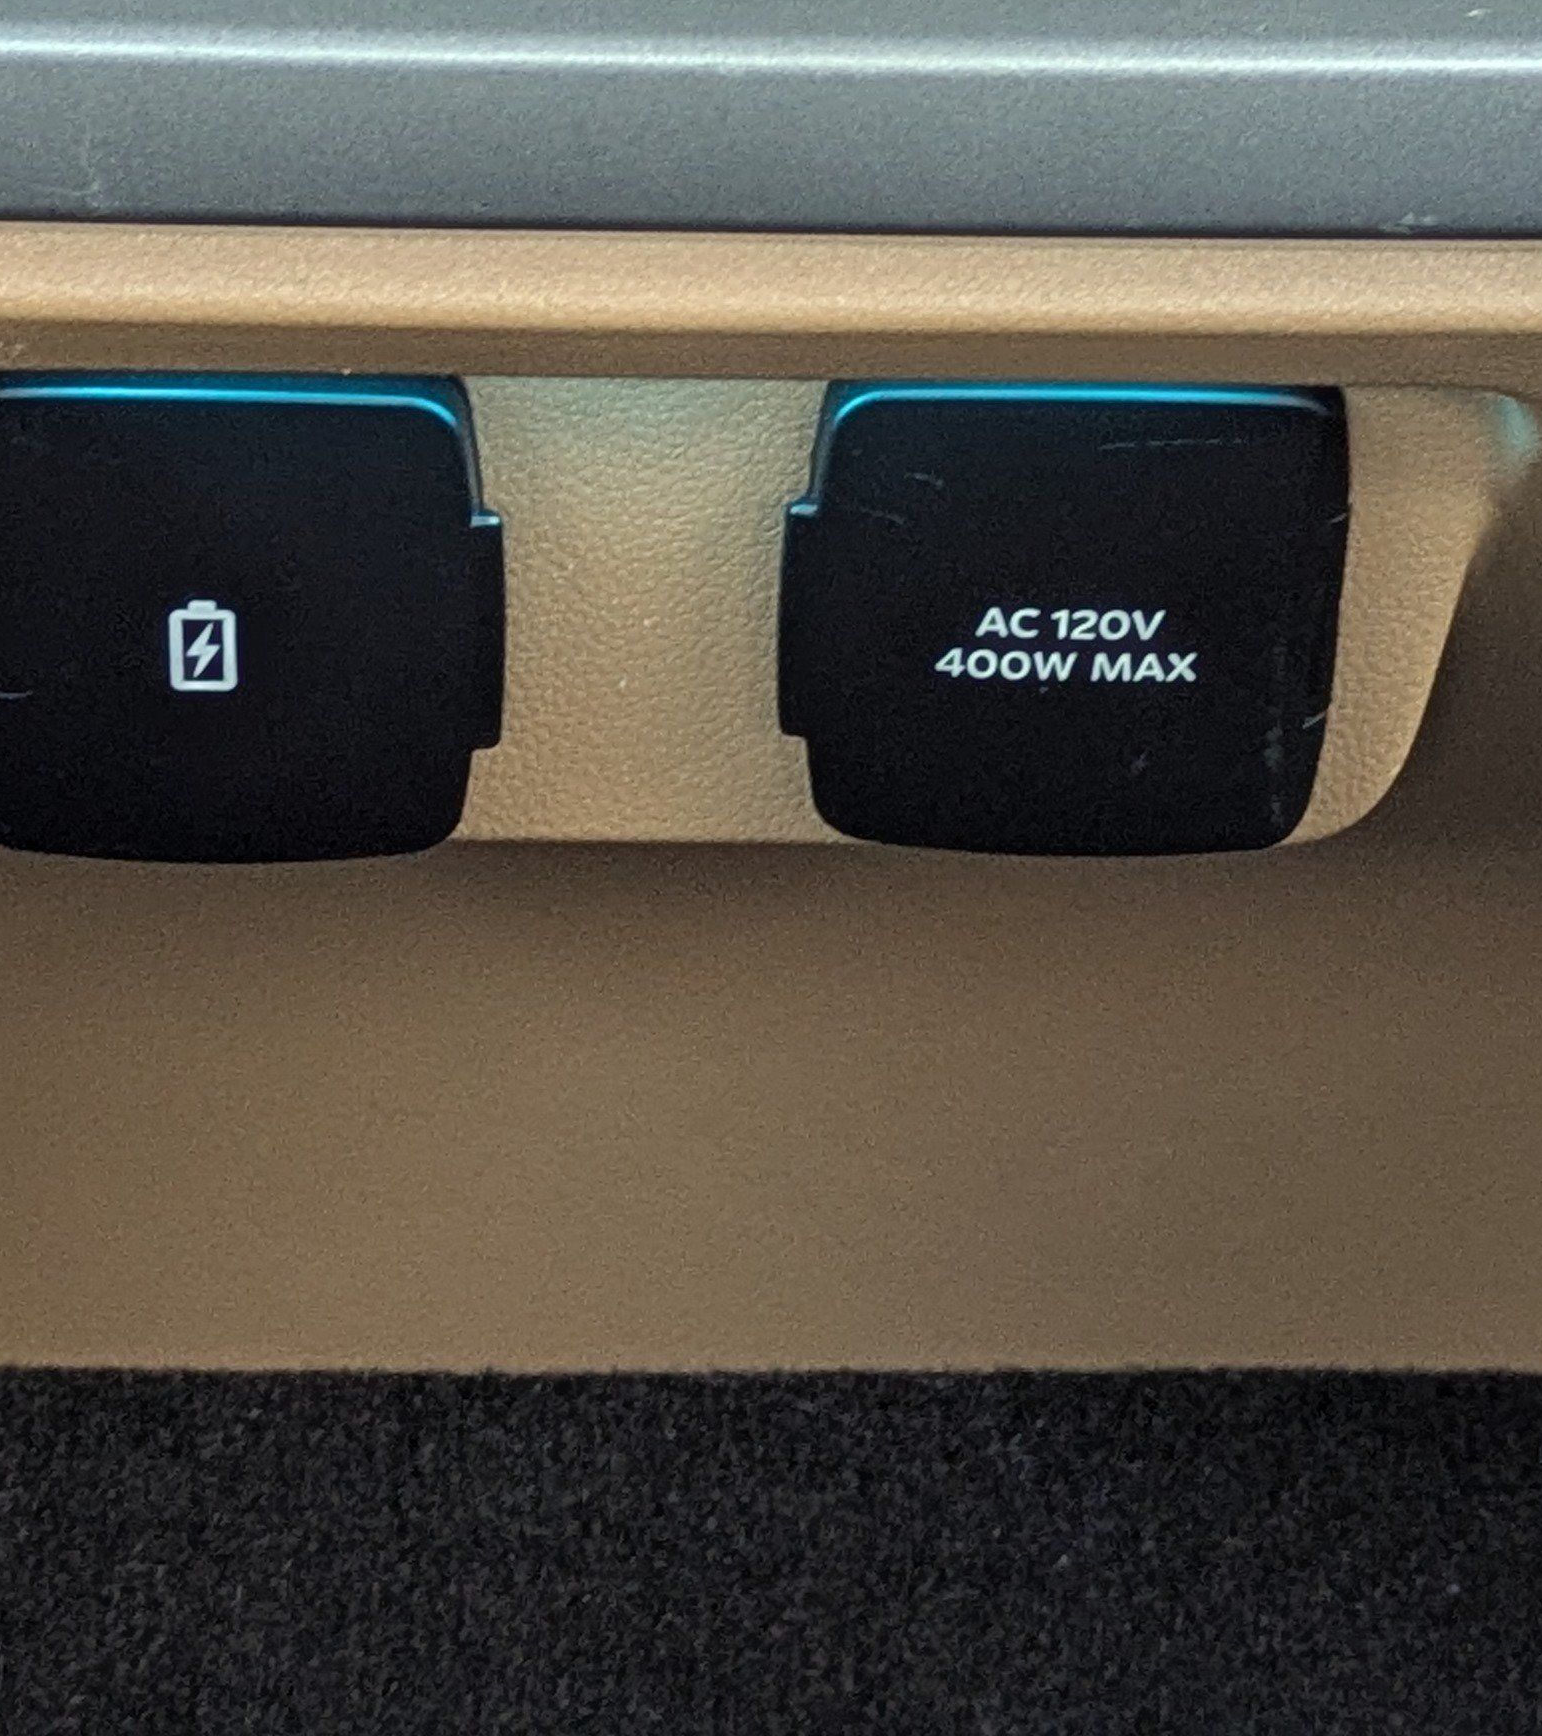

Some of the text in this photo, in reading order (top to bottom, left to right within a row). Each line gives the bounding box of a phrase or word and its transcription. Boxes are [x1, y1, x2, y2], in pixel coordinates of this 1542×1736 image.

[975, 606, 1166, 641] AC 120V
[934, 647, 1198, 682] 400W MAX
